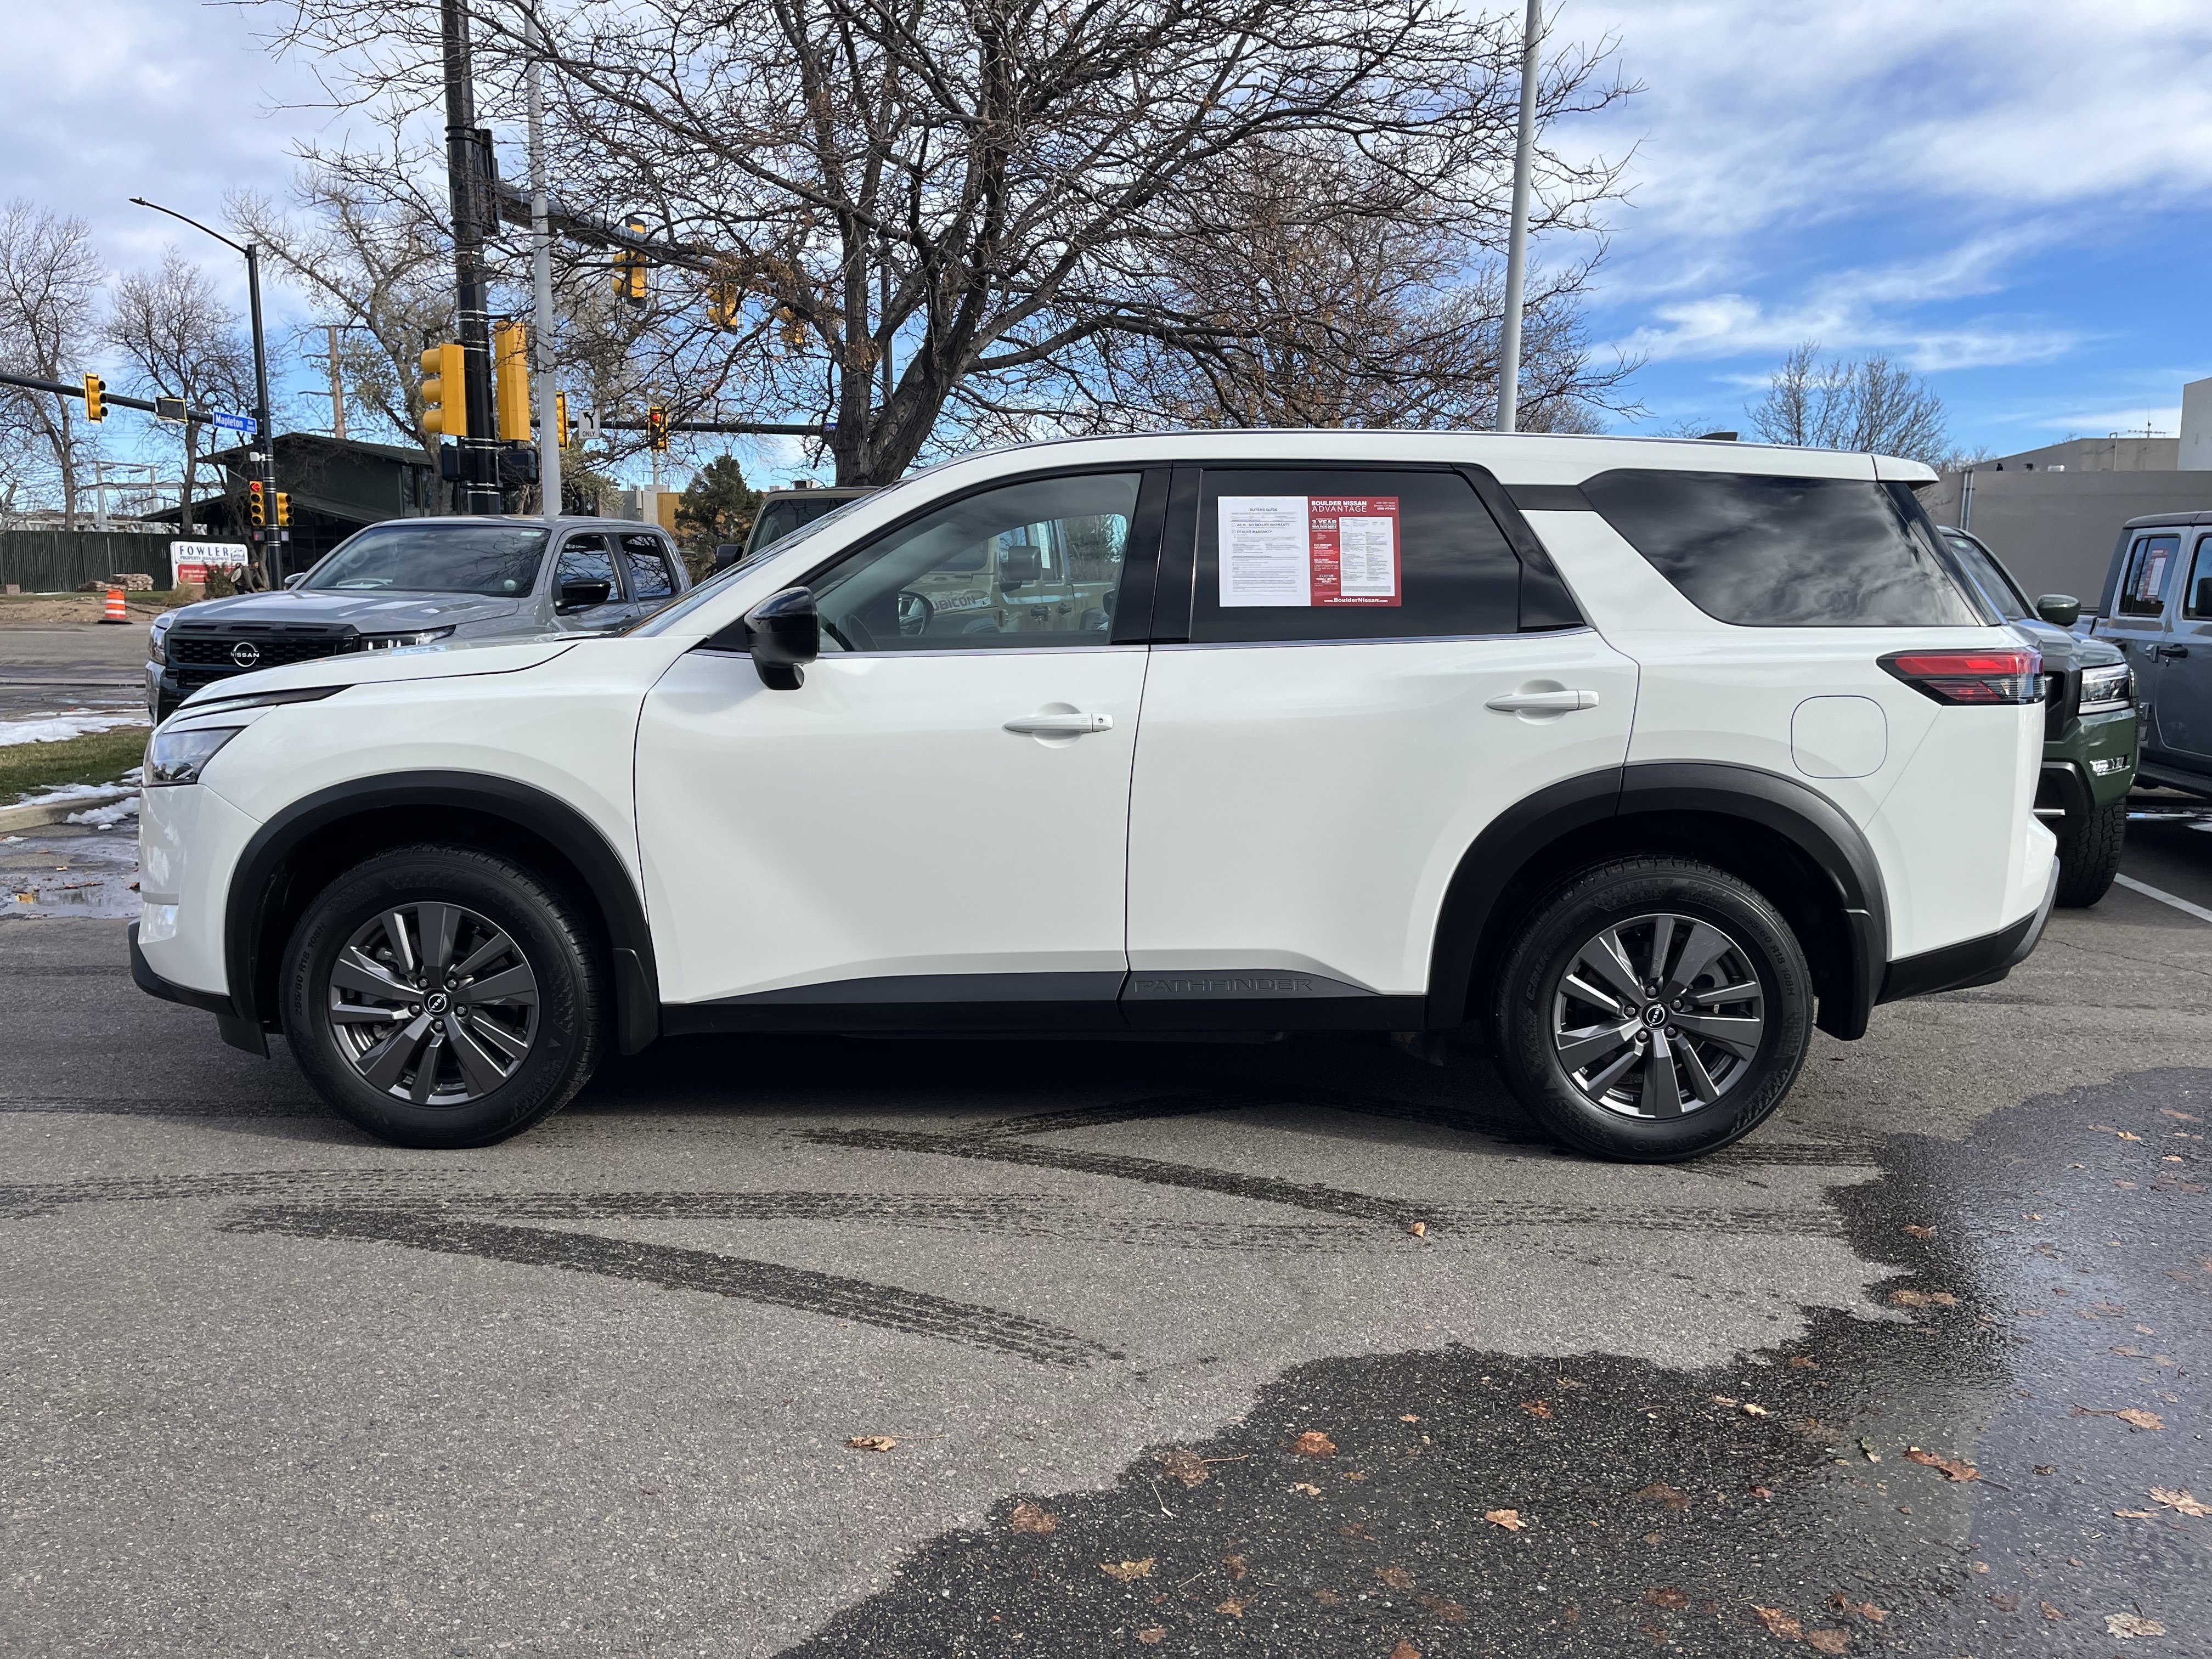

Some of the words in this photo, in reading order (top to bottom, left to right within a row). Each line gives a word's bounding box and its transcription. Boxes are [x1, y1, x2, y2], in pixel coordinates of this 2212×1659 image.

[216, 414, 244, 428] Mapleton
[180, 545, 229, 556] FOWLER
[932, 595, 976, 611] UBICON
[307, 921, 326, 949] 108H
[298, 951, 310, 973] R18
[1134, 978, 1313, 993] PATHFINDER
[294, 975, 304, 1017] 255/60
[428, 993, 447, 1013] NISSAN
[1649, 1003, 1662, 1027] NISSAN
